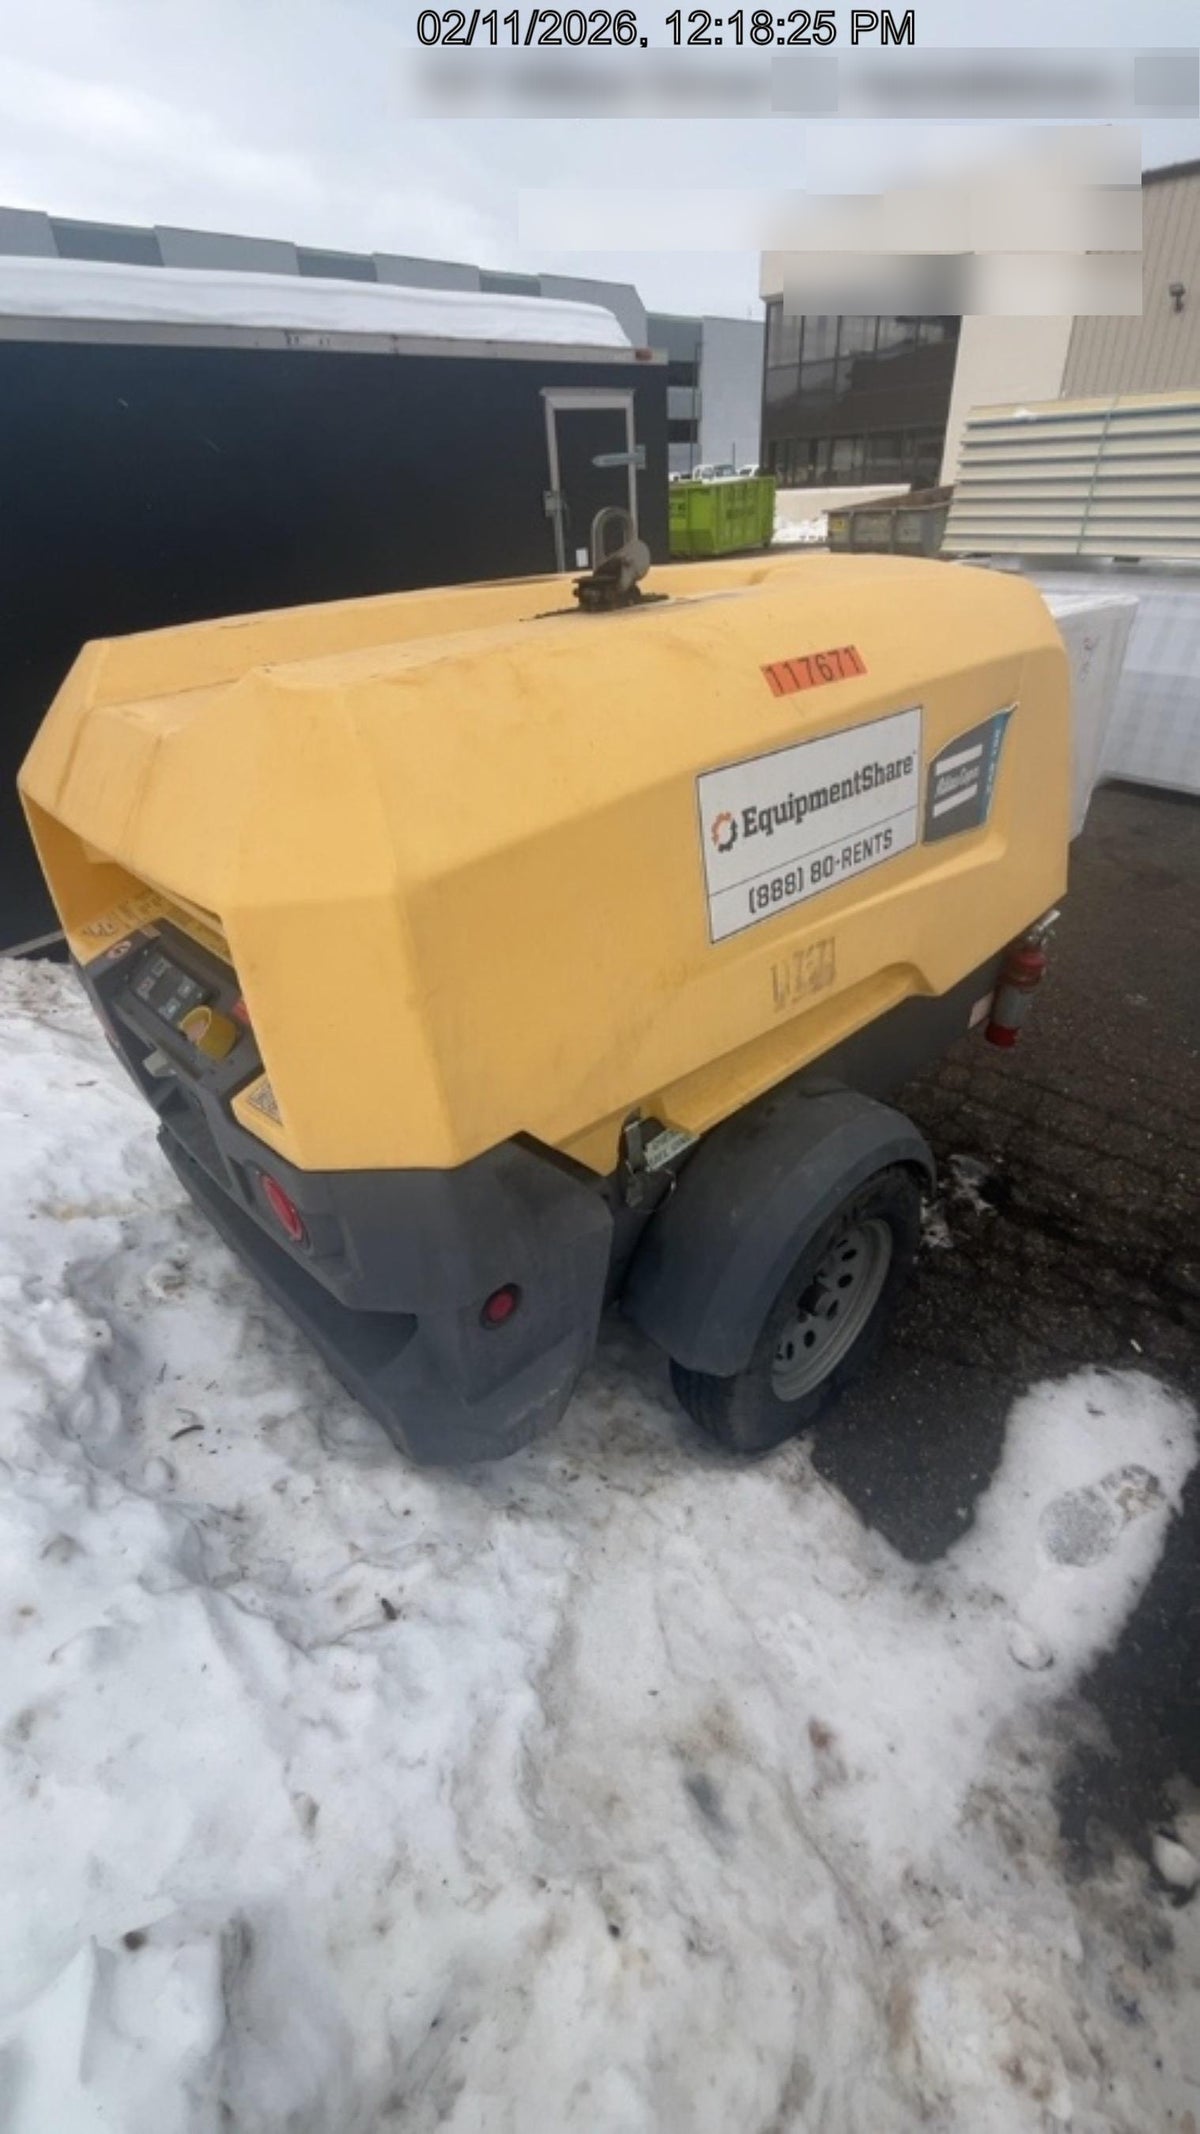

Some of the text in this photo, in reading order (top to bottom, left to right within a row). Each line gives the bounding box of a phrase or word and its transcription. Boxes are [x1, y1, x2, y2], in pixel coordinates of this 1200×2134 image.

[761, 645, 860, 695] 117671
[741, 755, 914, 838] EquipmentShare
[748, 828, 893, 914] (888) 80-RENTS
